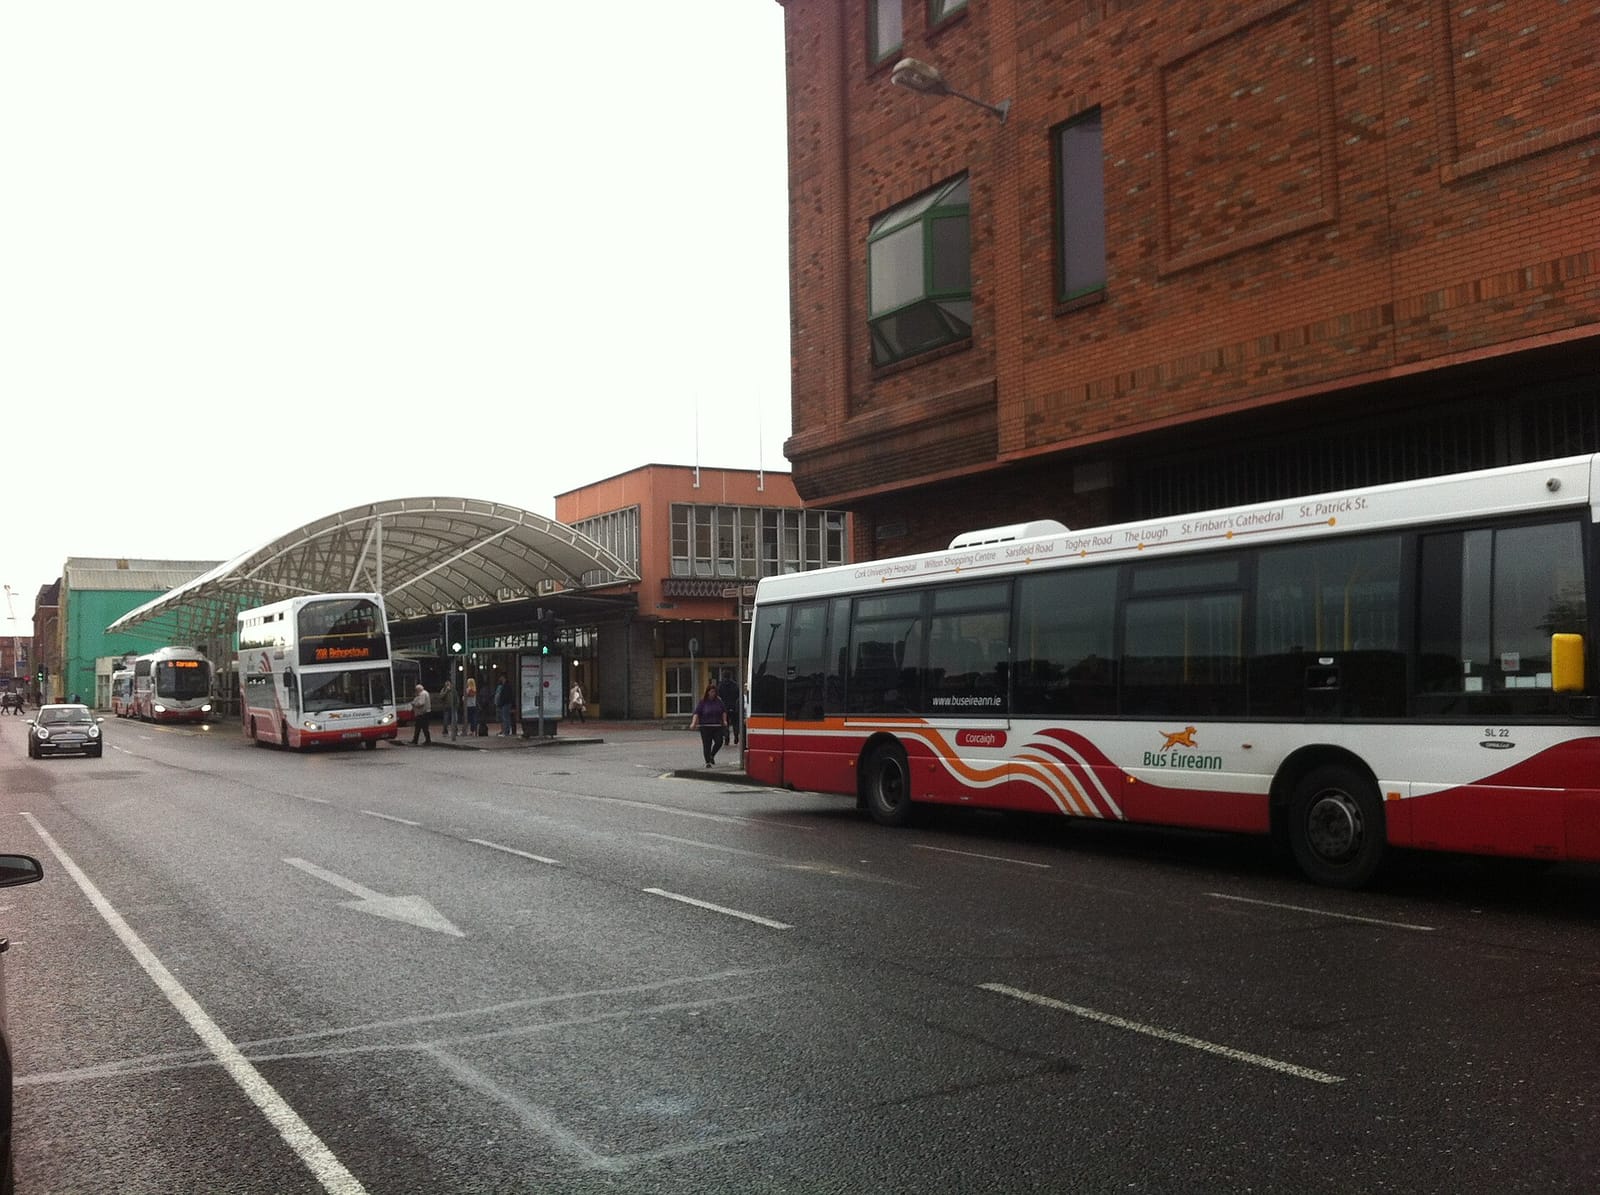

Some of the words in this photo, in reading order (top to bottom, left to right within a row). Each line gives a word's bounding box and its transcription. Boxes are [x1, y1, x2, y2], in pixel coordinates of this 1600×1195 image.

[1300, 506, 1313, 518] St.
[1315, 501, 1352, 516] Patrick
[1354, 498, 1368, 510] St.
[1181, 523, 1193, 535] St.
[1195, 518, 1234, 533] Finbarr's
[1235, 510, 1284, 528] Cathedral
[1065, 538, 1091, 551] Togher
[1092, 534, 1113, 546] Road
[1125, 531, 1140, 542] The
[1141, 527, 1168, 543] Lough
[1005, 544, 1035, 558] Sarsfield
[1035, 542, 1054, 553] Road
[924, 558, 943, 569] Wilton
[944, 554, 974, 567] Shopping
[974, 551, 996, 562] Centre
[867, 566, 893, 578] University
[893, 562, 917, 574] Hospital
[932, 696, 1001, 707] www.buseireann.ie
[965, 732, 996, 745] Corcaigh
[1484, 728, 1497, 737] SL
[1498, 728, 1510, 738] 22
[1143, 751, 1167, 767] Bus
